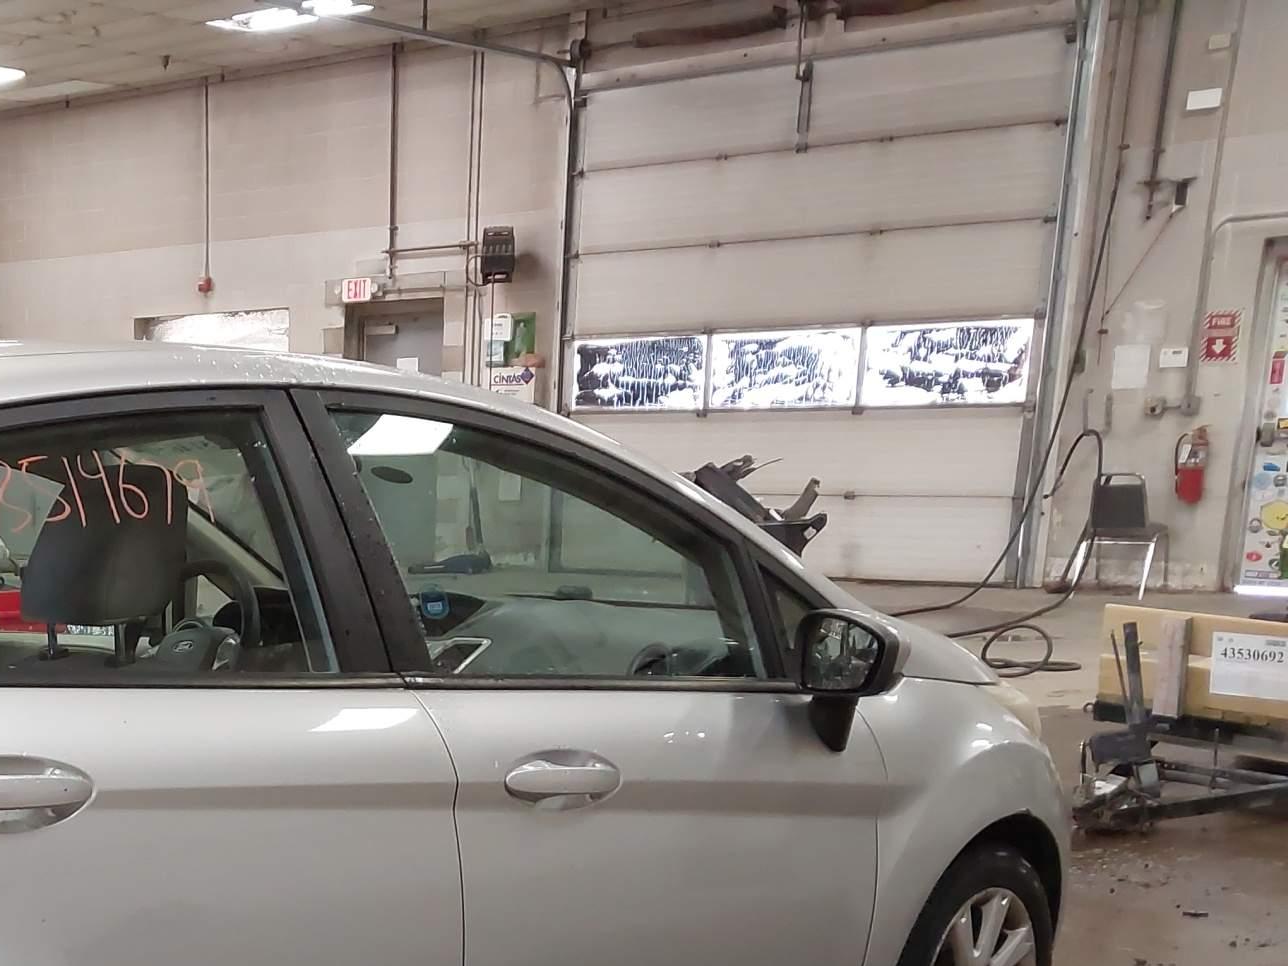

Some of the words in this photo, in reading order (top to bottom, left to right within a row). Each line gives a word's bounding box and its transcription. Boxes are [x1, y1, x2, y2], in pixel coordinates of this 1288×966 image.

[347, 279, 367, 299] EXIT
[1211, 316, 1233, 326] FIRE
[1220, 647, 1284, 663] 43530692
